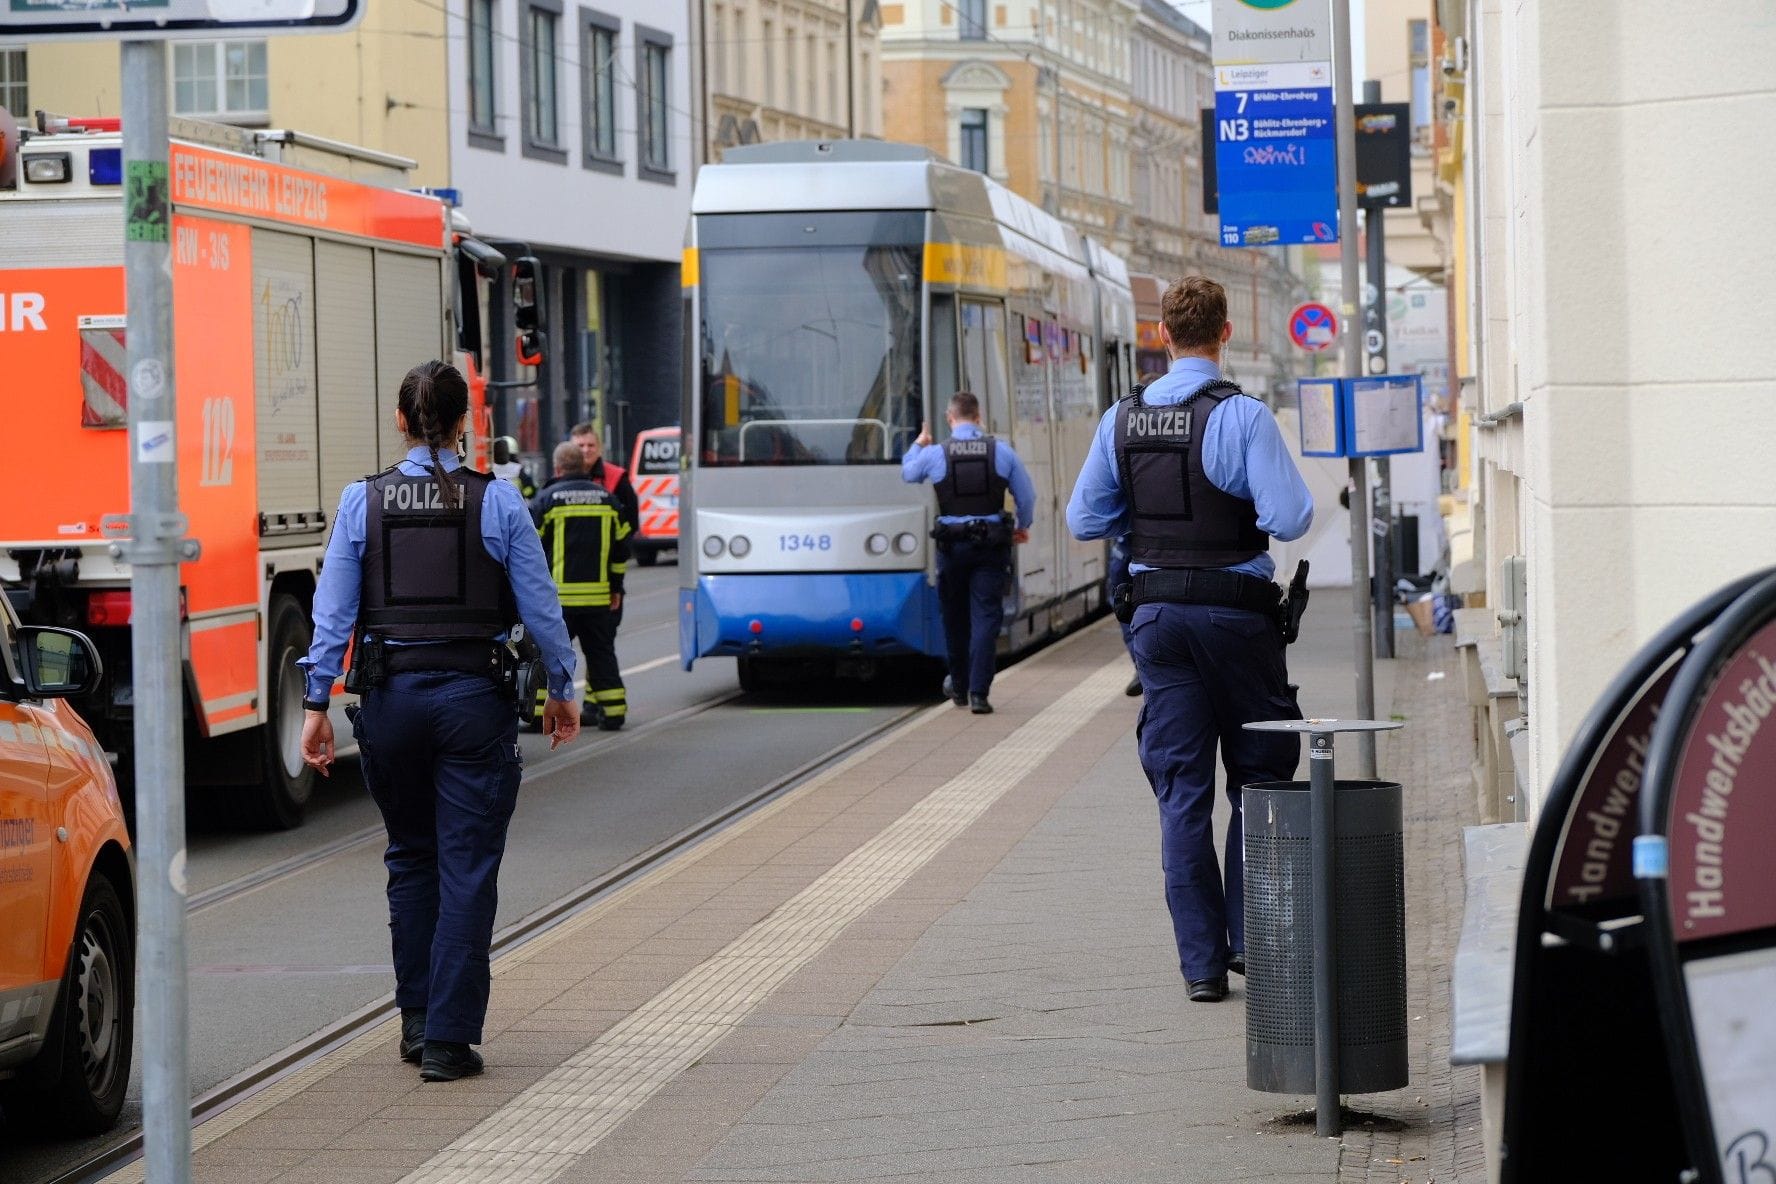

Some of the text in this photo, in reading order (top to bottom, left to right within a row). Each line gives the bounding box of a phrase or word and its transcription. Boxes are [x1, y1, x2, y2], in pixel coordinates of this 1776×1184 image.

[1228, 27, 1316, 41] Diakonissenhaus
[1235, 92, 1249, 114] 7
[1220, 119, 1249, 142] N3
[175, 152, 328, 222] FEUERWEHR LEIPZIG
[176, 225, 199, 266] RW
[1223, 233, 1240, 244] 110
[1126, 411, 1192, 437] POLIZEI
[199, 397, 235, 487] 112
[950, 441, 998, 455] POLIZEI
[383, 482, 465, 510] POLIZI
[779, 534, 832, 552] 1348
